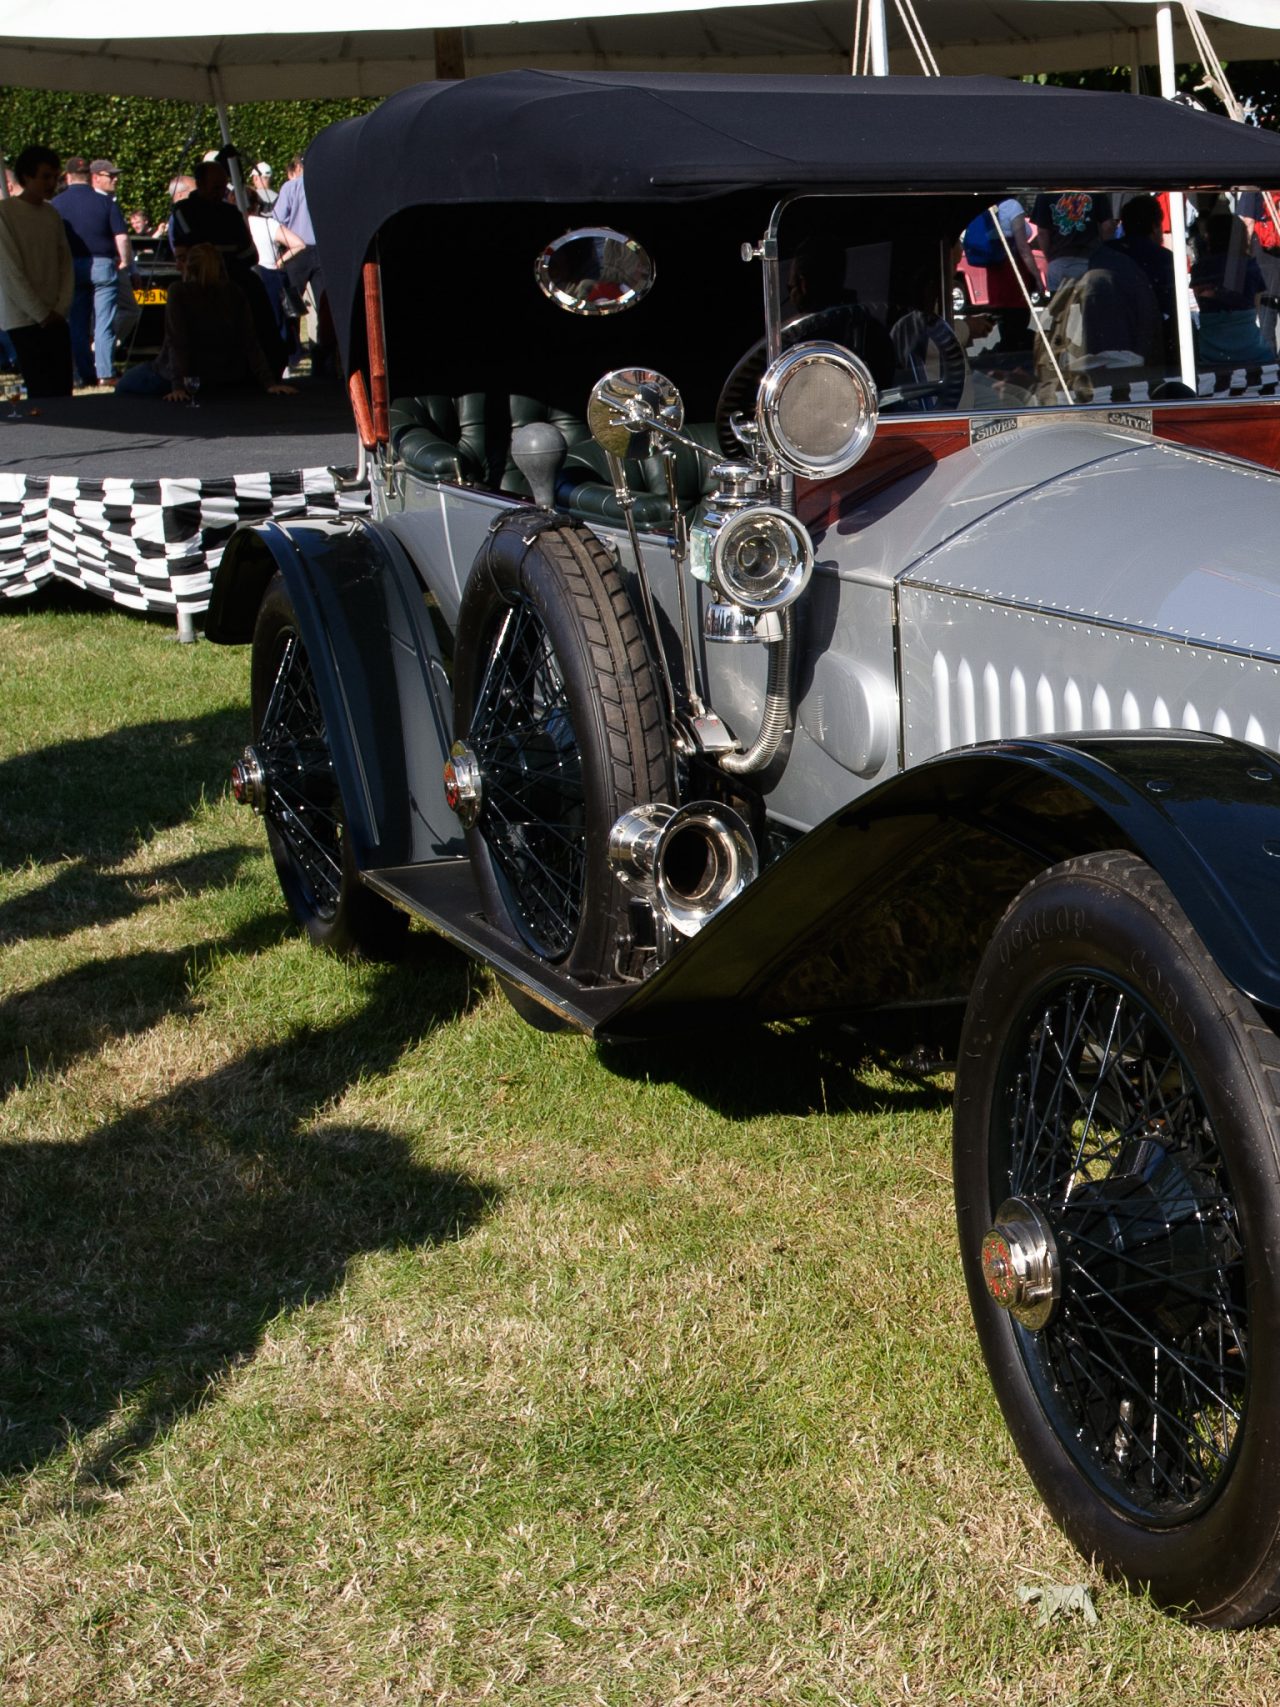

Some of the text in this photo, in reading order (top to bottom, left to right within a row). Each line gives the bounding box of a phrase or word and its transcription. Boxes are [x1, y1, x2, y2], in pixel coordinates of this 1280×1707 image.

[975, 412, 1151, 441] SILVER SATYR
[1129, 947, 1197, 1048] CORD
